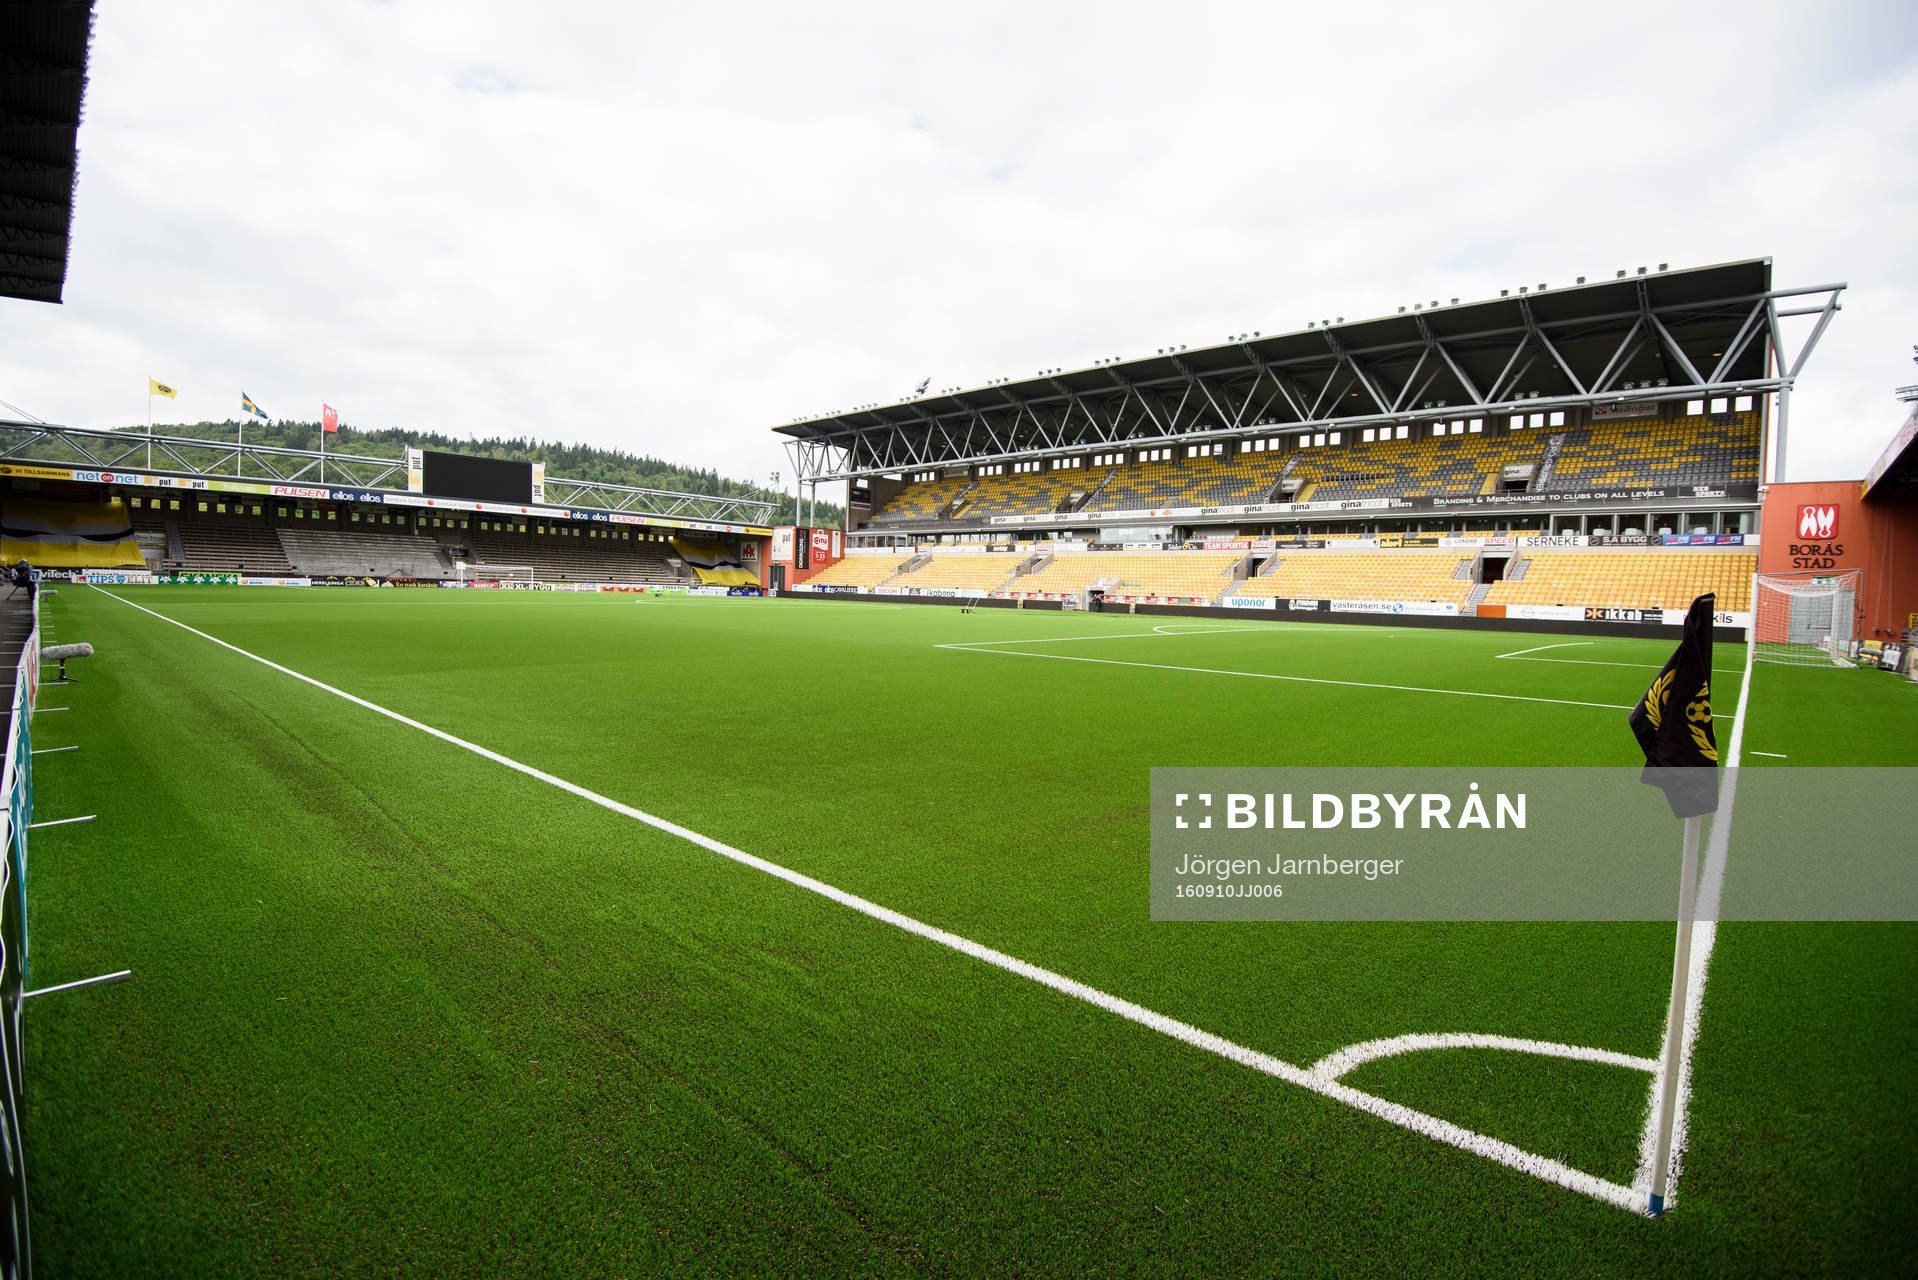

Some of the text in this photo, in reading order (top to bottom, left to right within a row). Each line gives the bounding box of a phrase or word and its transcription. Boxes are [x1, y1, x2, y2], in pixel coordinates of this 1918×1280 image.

[159, 478, 172, 486] put
[274, 487, 327, 498] PULSEN
[1486, 495, 1546, 503] MERCHANDISE
[1631, 490, 1665, 498] LEVELS
[1526, 537, 1579, 546] SERNEKE
[1789, 542, 1844, 555] BORÅS
[1793, 558, 1835, 568] STAD
[88, 575, 115, 583] TIPS
